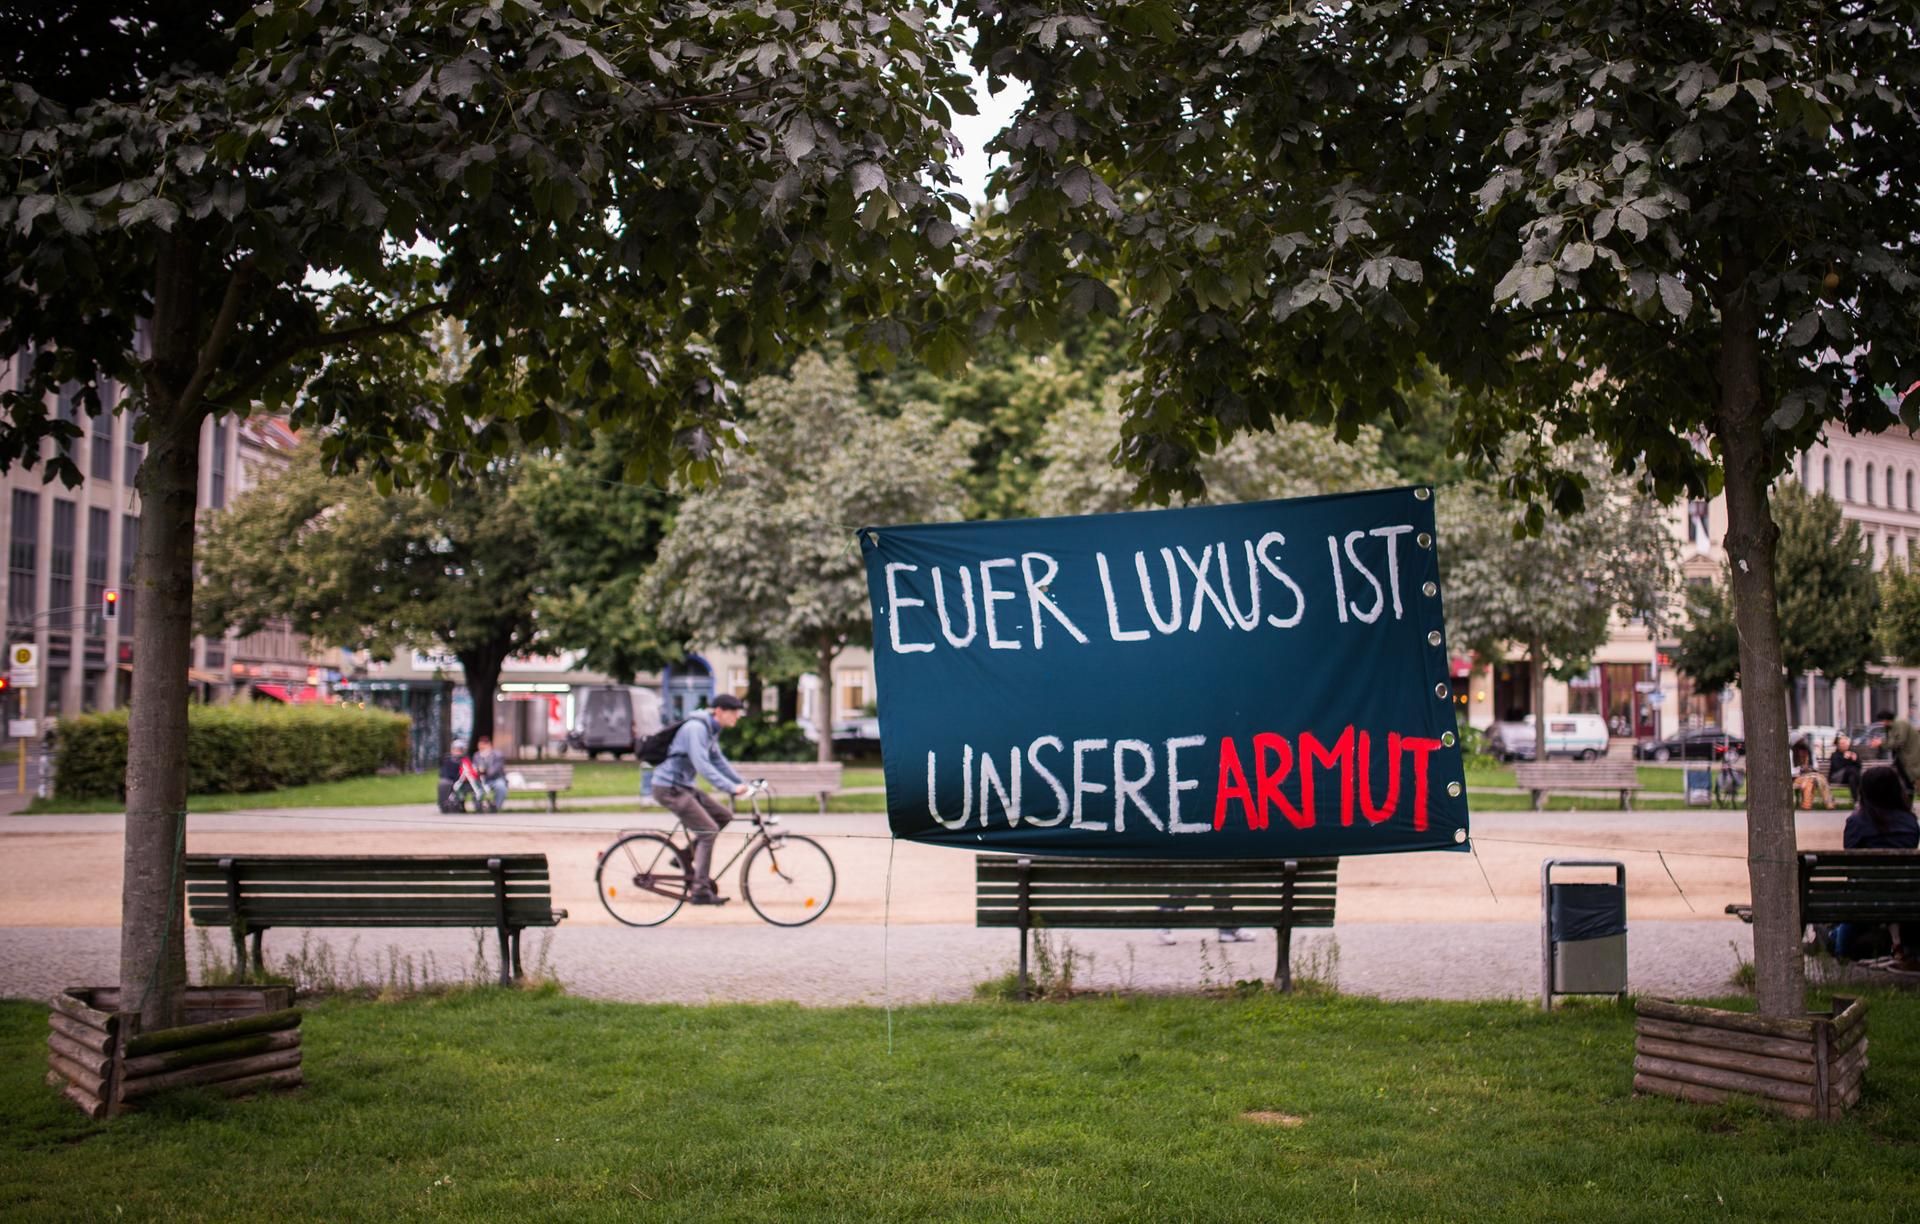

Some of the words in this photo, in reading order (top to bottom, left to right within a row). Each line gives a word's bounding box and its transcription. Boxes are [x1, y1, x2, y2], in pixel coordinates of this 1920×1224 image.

[884, 553, 1088, 653] EUER
[1096, 532, 1305, 642] LUXUS
[1328, 524, 1414, 624] IST
[927, 736, 1213, 834] UNSERE
[1213, 724, 1442, 832] ARMUT
